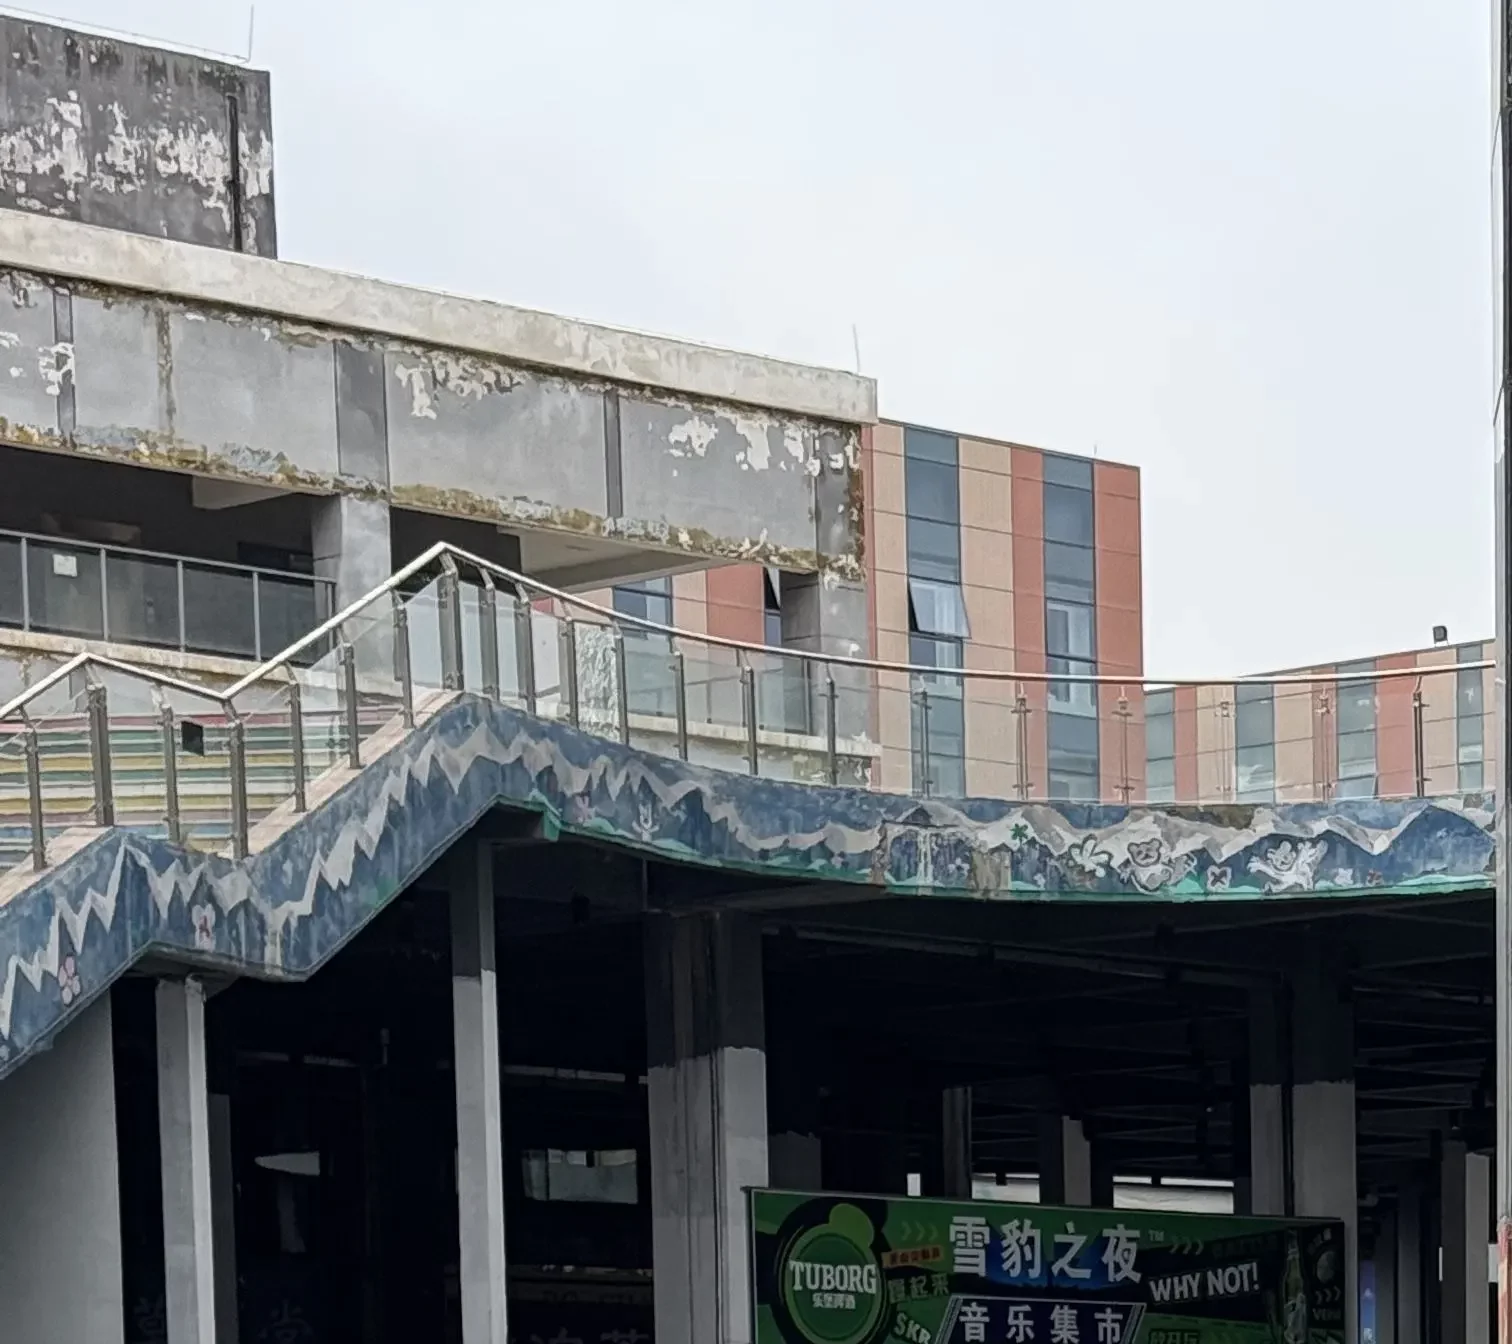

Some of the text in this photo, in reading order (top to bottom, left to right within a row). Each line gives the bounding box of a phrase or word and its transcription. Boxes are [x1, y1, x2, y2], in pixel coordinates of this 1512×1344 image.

[949, 1216, 1142, 1284] 雪豹之夜
[789, 1260, 878, 1295] TUBORG
[1149, 1262, 1261, 1304] WHY NOT!
